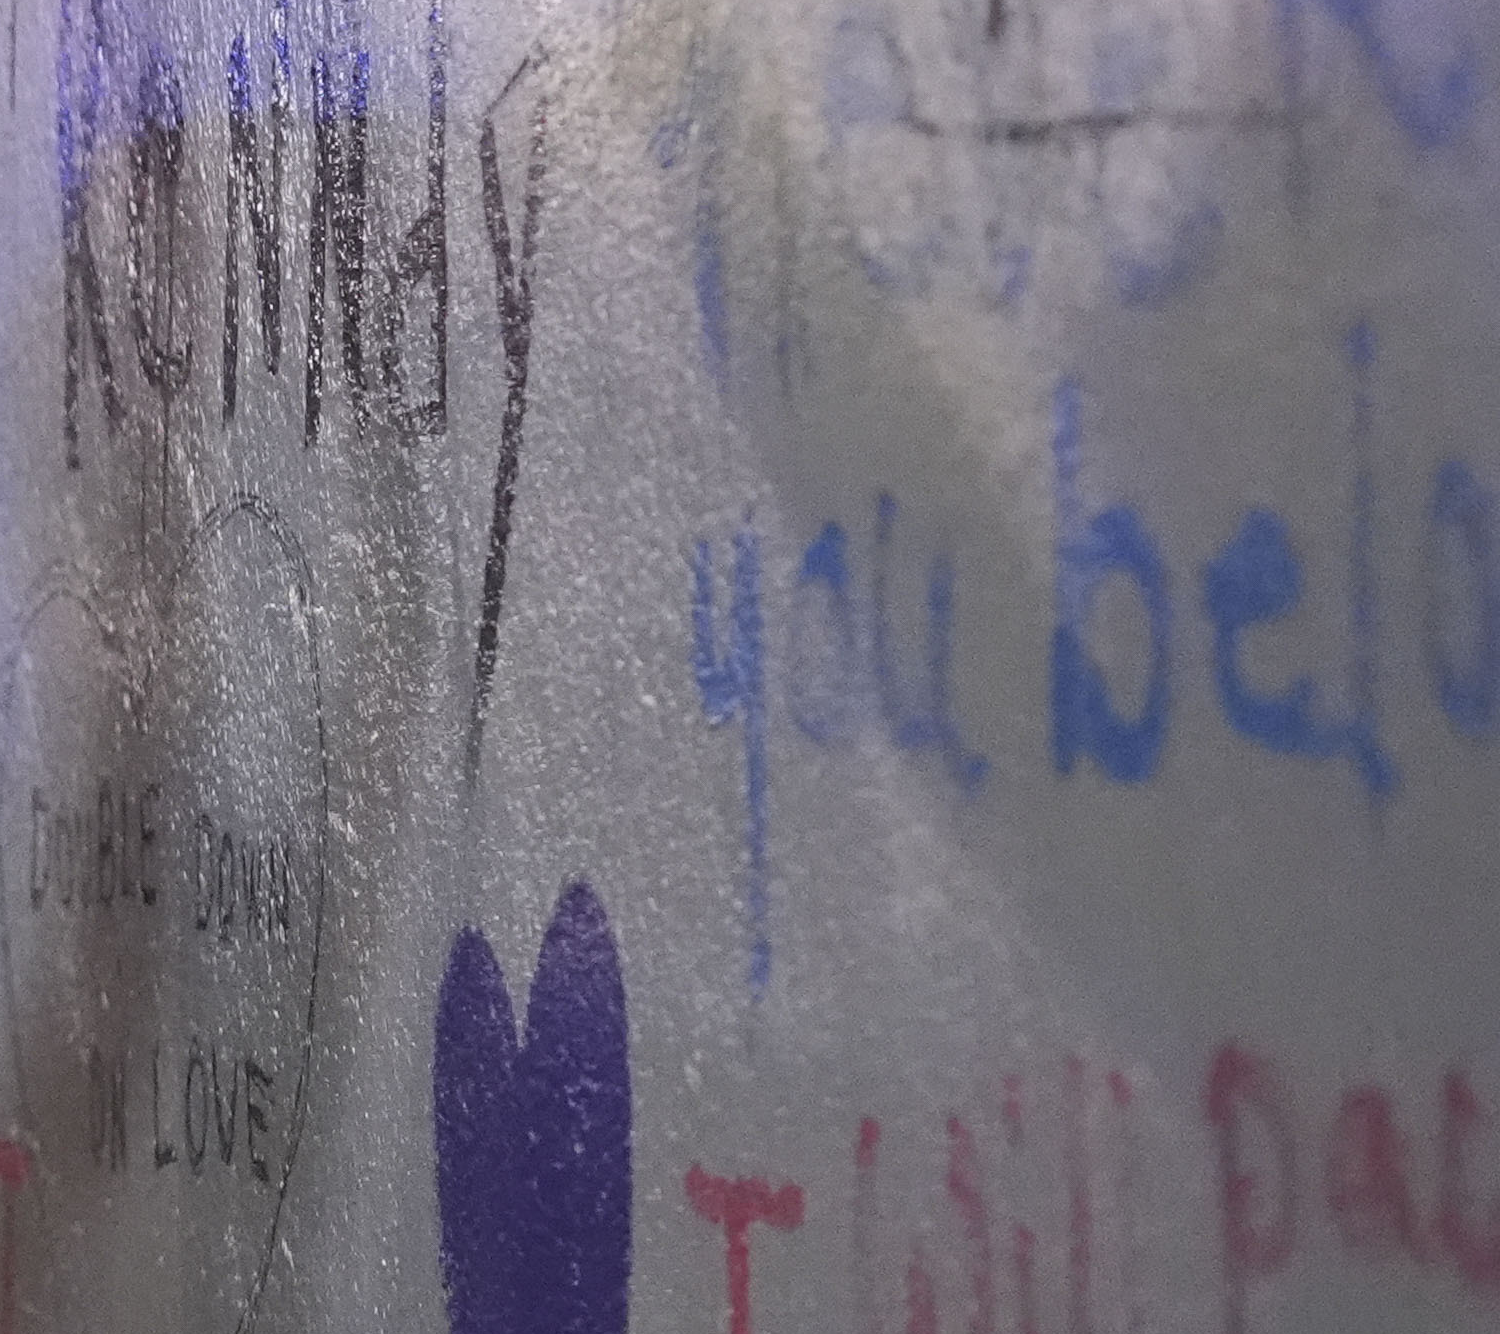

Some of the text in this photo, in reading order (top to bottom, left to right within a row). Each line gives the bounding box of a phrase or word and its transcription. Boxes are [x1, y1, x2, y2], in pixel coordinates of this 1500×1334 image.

[29, 775, 292, 941] DOUBLE DOWN
[154, 1033, 276, 1183] LOVE
